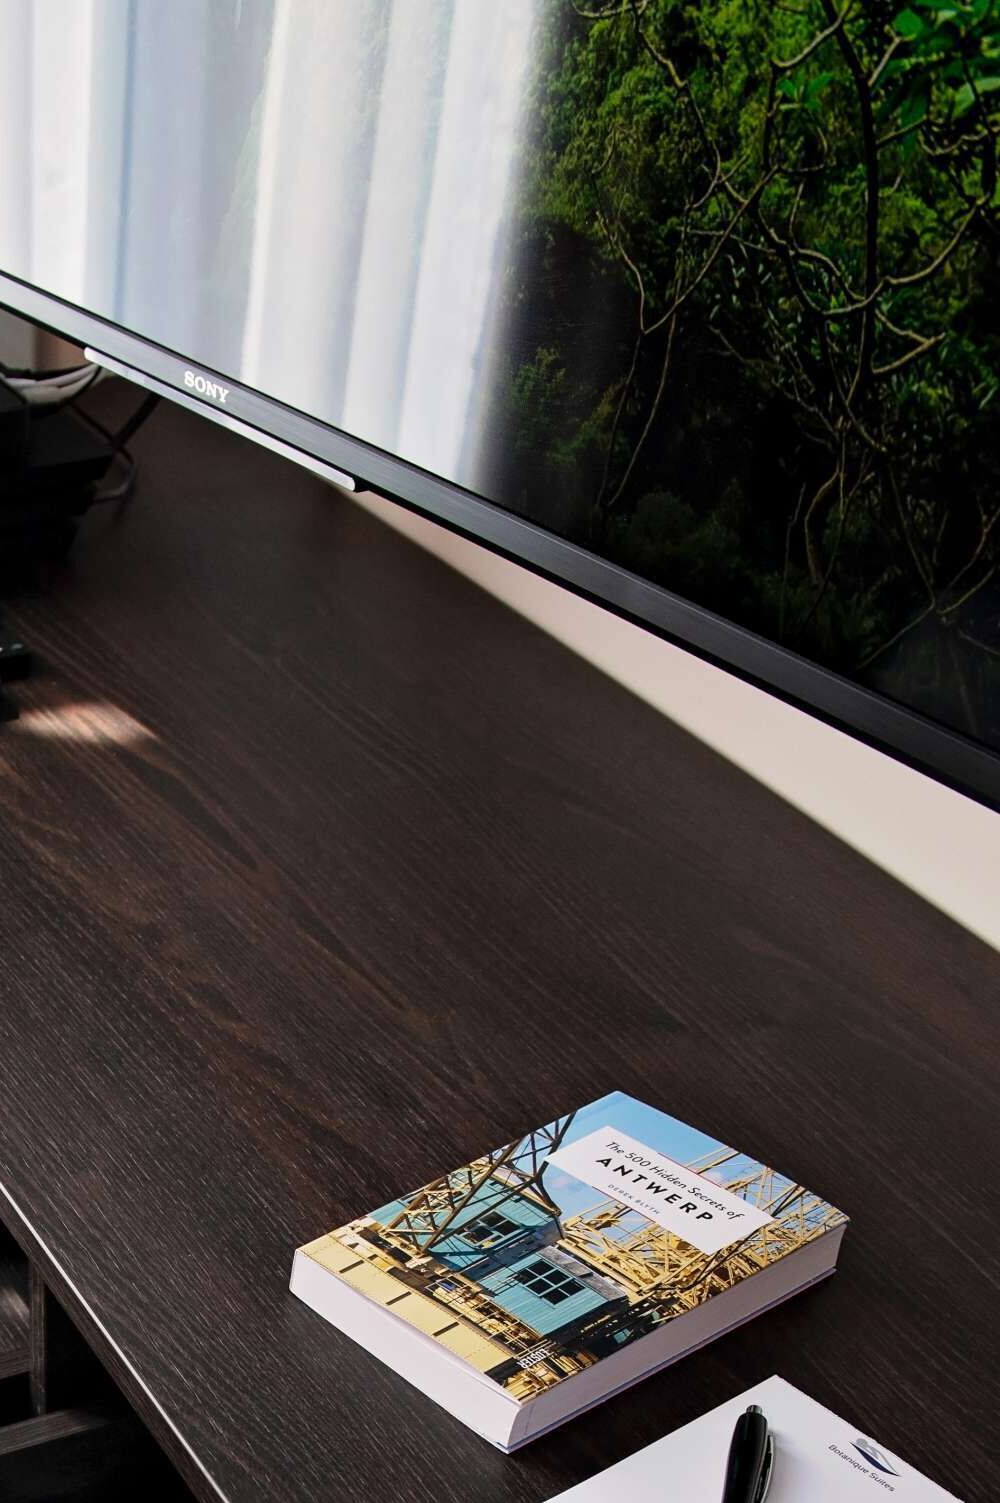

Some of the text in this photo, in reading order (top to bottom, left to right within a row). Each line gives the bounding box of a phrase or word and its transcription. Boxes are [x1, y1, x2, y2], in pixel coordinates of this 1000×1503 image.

[184, 370, 229, 403] SONY
[595, 1158, 713, 1221] ANTWERP
[605, 1141, 744, 1220] The 500 Hidden Secrets of
[608, 1184, 661, 1215] DEREK BLYTH
[828, 1444, 895, 1492] Botanique Suites
